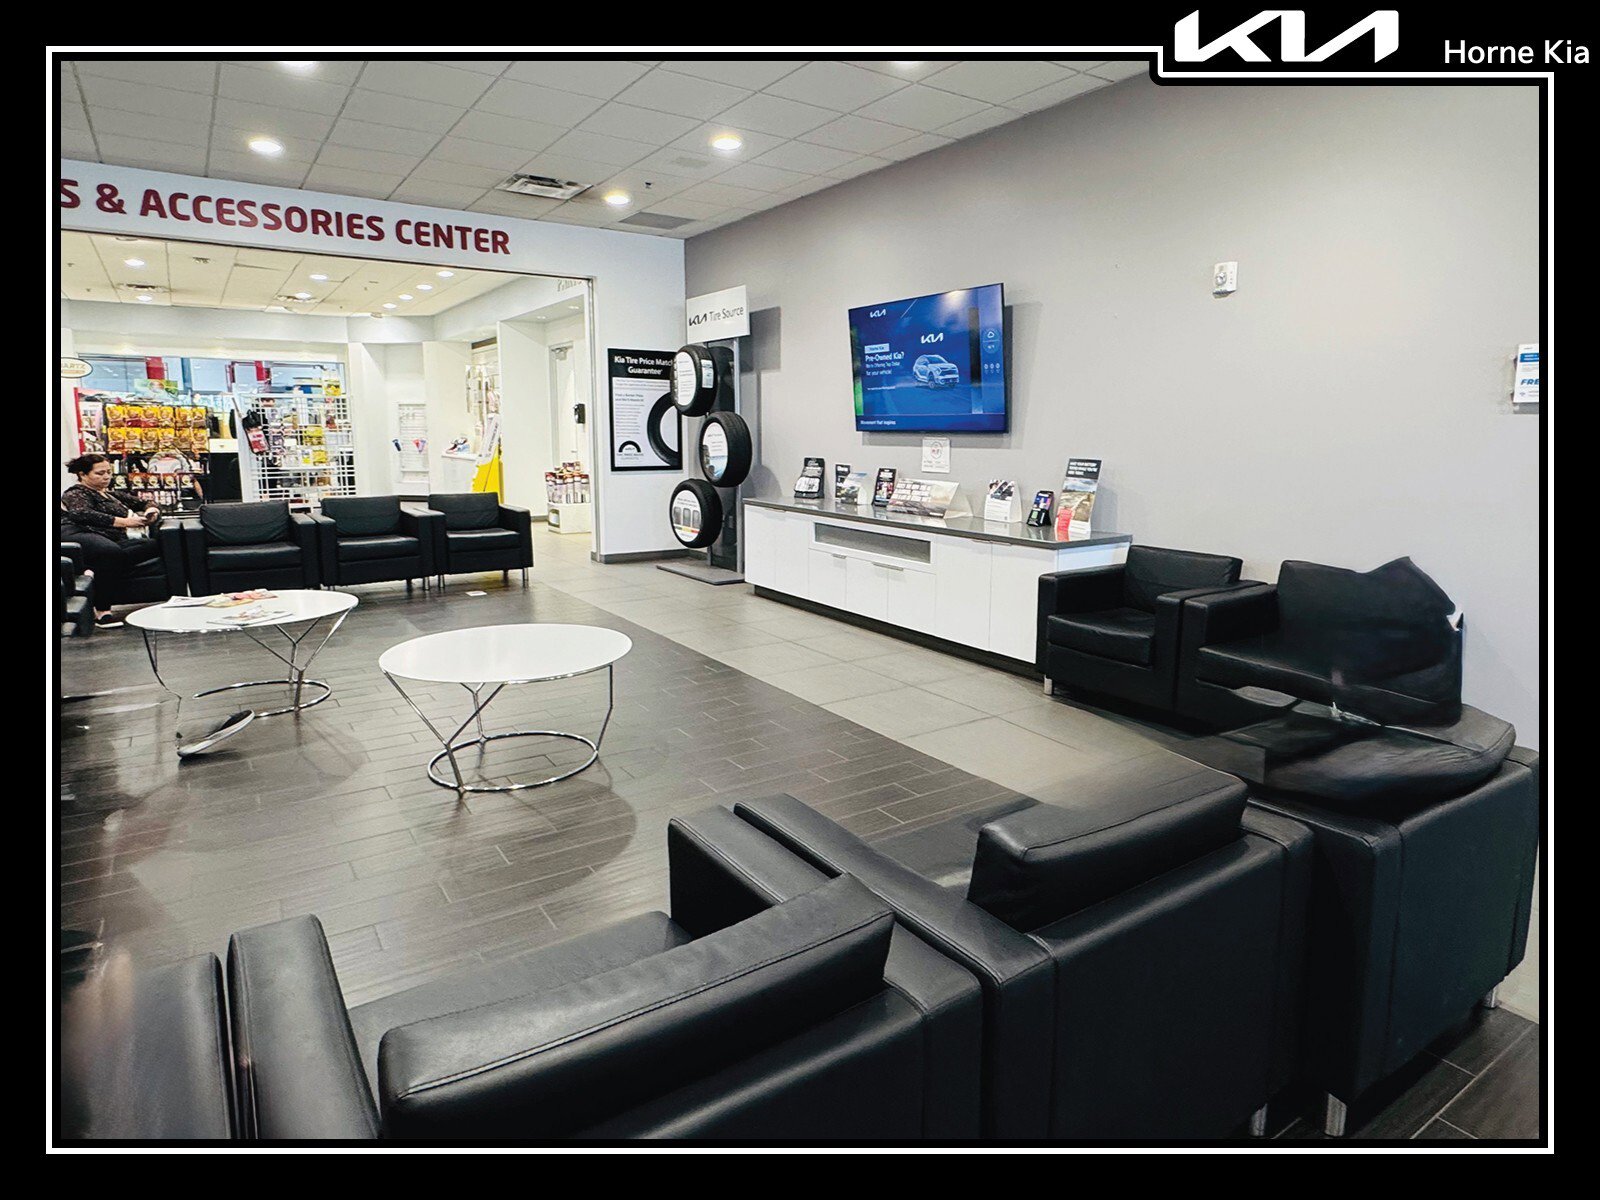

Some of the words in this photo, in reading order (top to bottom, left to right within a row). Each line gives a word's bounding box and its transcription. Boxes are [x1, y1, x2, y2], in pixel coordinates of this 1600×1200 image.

[96, 183, 127, 215] &
[139, 188, 385, 242] ACCESSORIES
[395, 219, 511, 255] CENTER
[722, 307, 744, 319] Source
[614, 356, 625, 364] Kia
[626, 356, 638, 365] Tire
[639, 357, 655, 366] Price
[865, 353, 892, 361] Pre-Owned
[893, 351, 904, 359] Kia?
[628, 366, 661, 375] Guarantee
